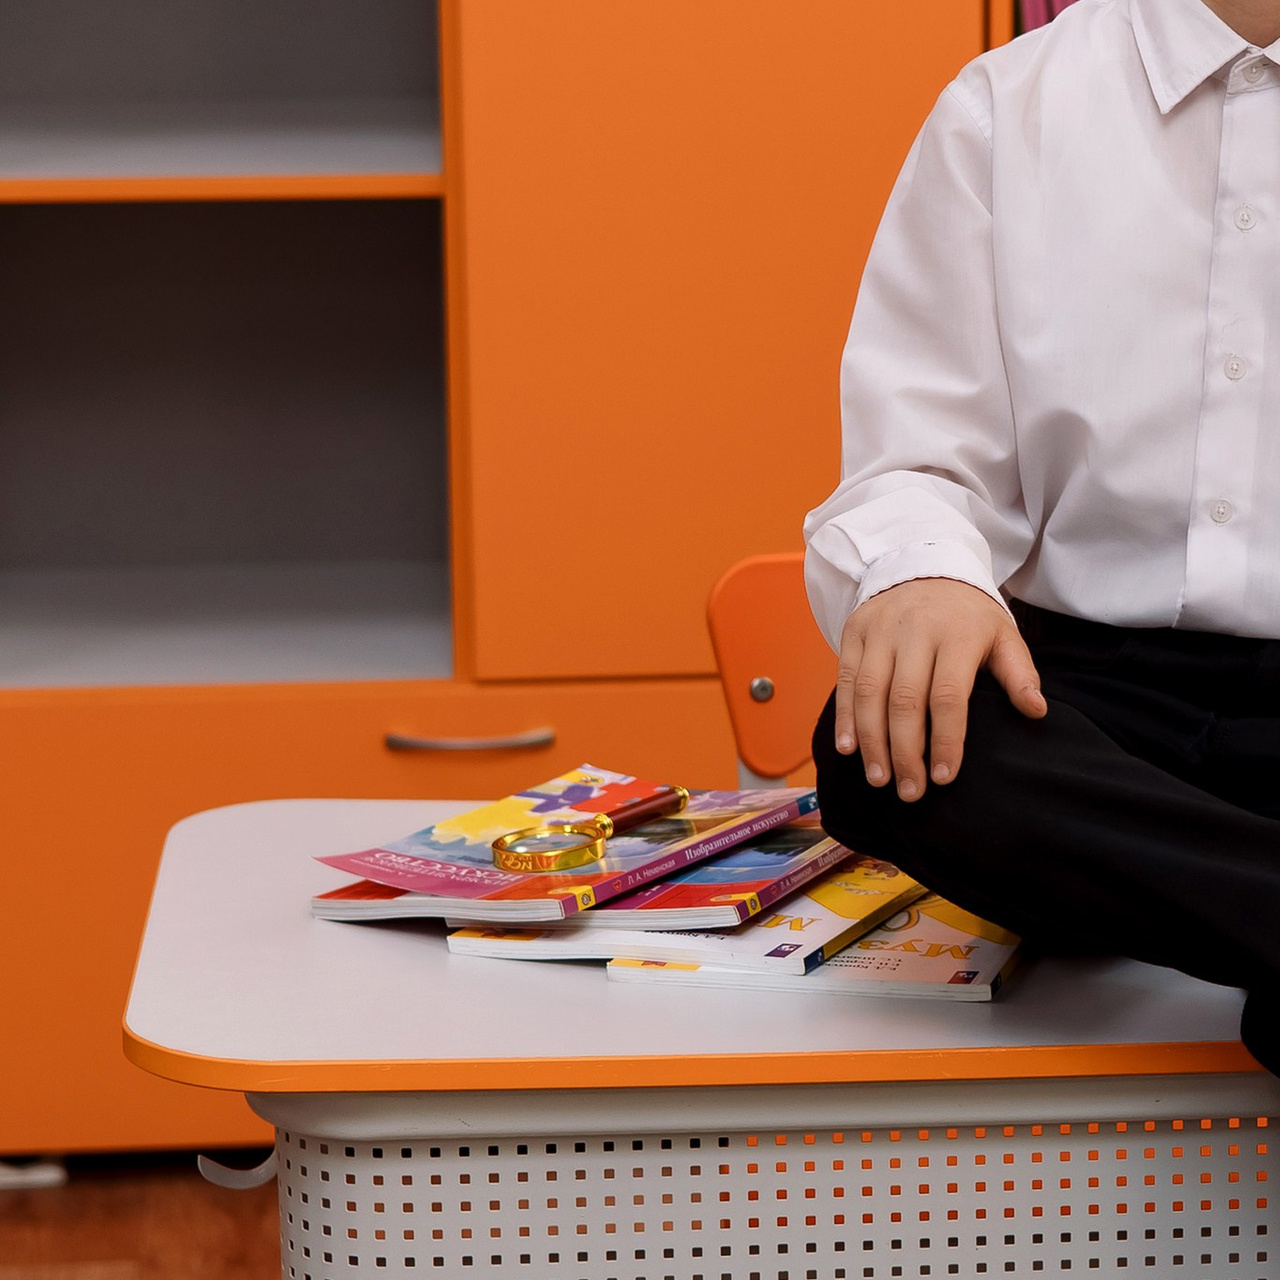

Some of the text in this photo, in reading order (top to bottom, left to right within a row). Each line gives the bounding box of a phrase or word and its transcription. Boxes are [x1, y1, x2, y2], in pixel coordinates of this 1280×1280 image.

[685, 827, 751, 862] Изобразительное
[752, 809, 789, 834] искусство
[851, 938, 980, 960] Муз
